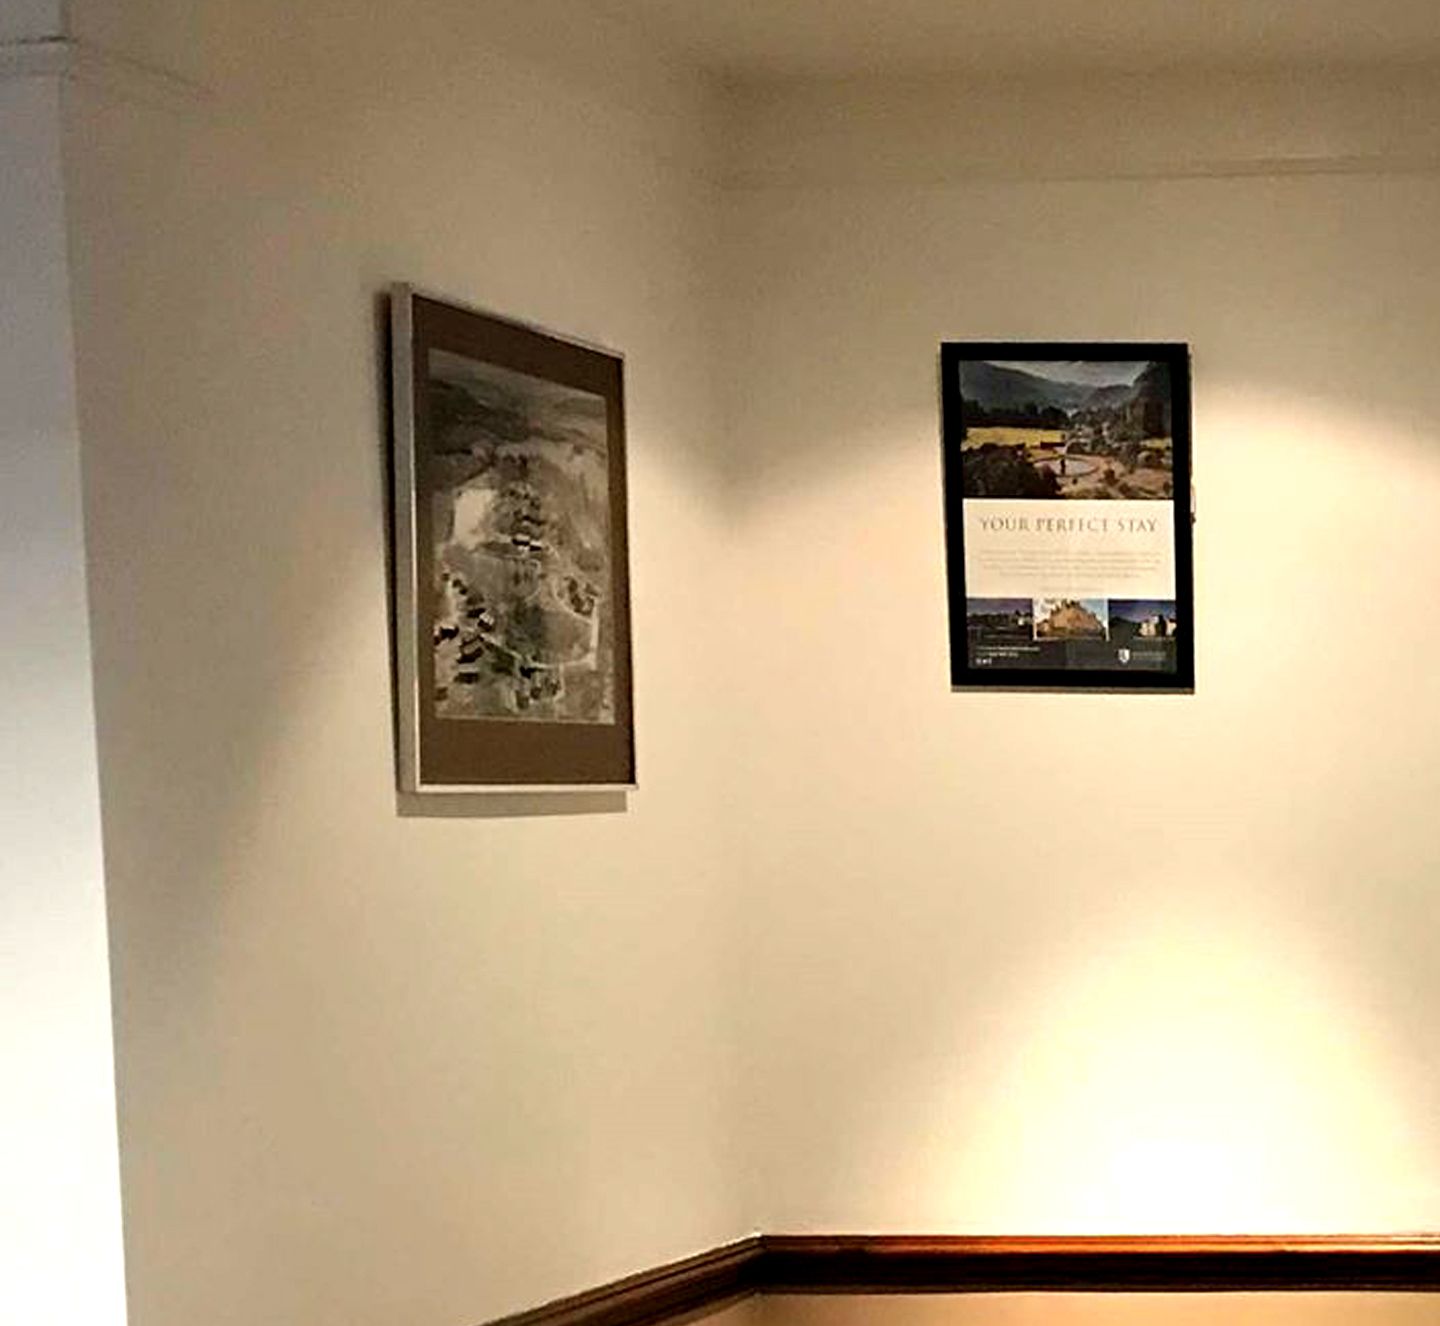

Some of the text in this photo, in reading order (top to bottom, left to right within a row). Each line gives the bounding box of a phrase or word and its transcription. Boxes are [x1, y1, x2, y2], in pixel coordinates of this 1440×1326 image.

[980, 516, 1158, 533] YOUR PERFECT STAY
